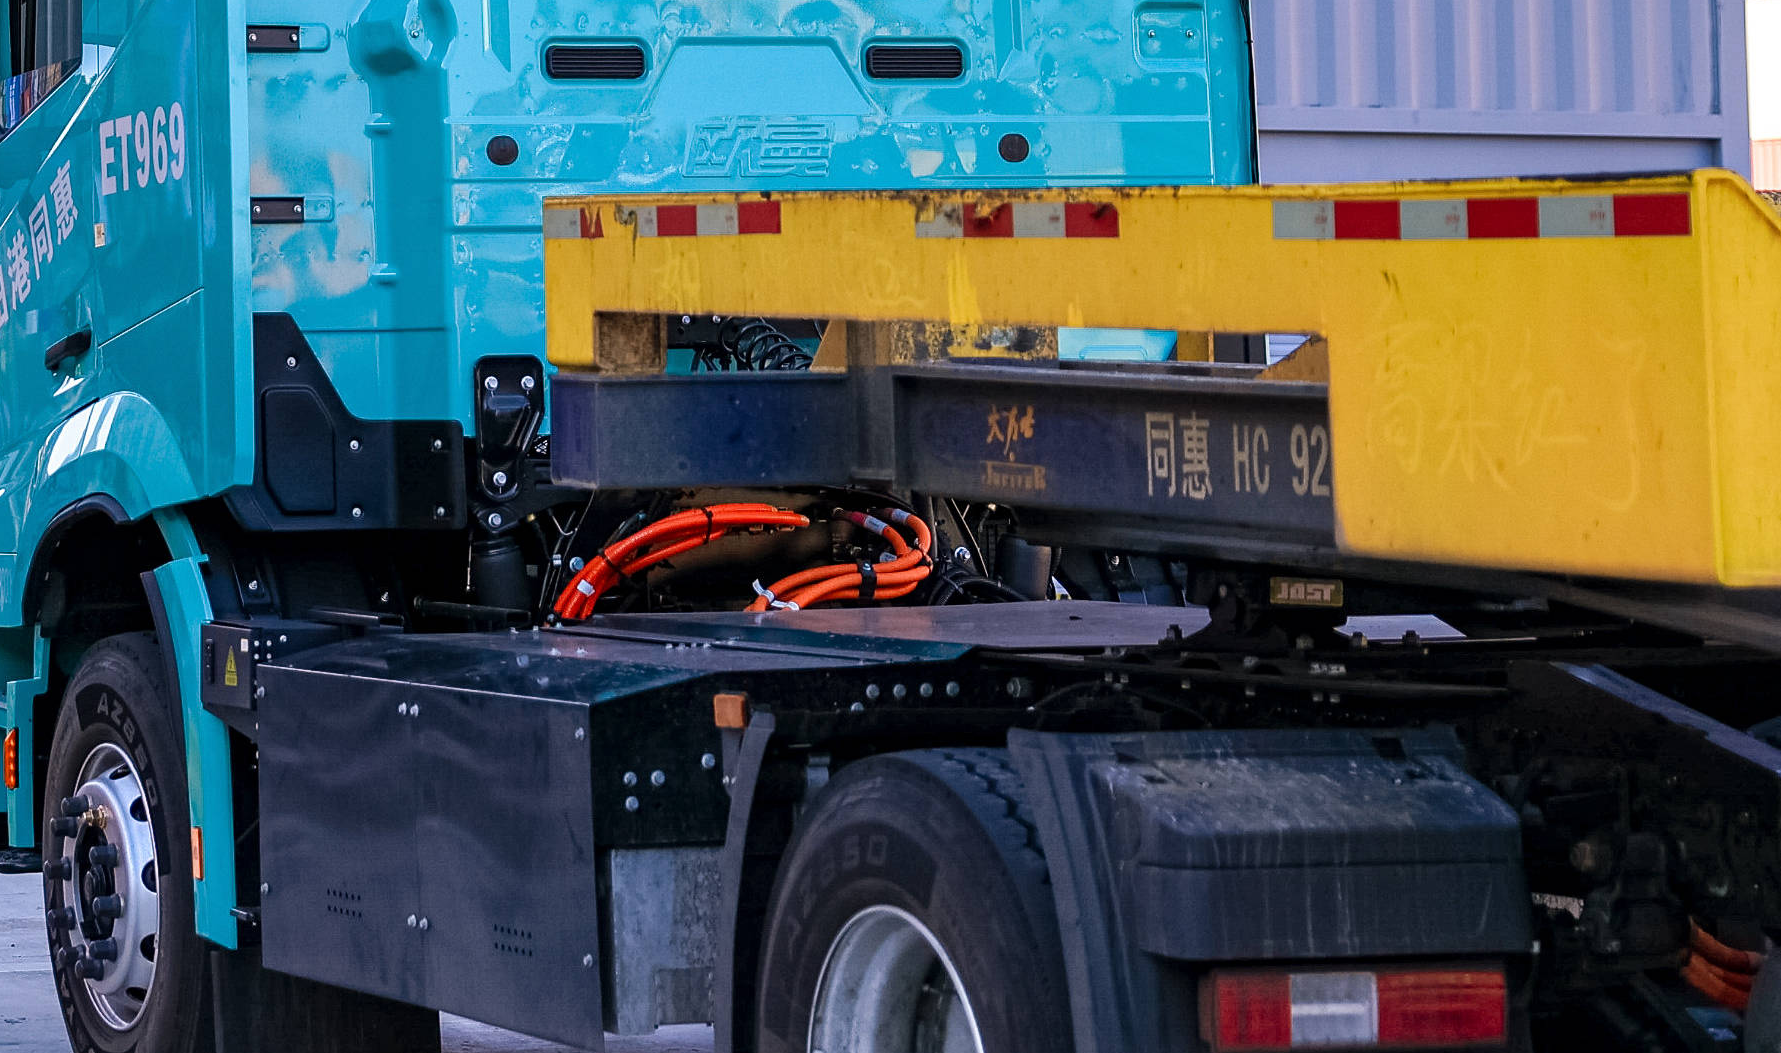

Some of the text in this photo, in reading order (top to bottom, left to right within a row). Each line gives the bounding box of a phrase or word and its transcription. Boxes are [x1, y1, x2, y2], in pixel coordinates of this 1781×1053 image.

[99, 101, 186, 196] ET969
[1145, 410, 1331, 500] 同惠 HC 92
